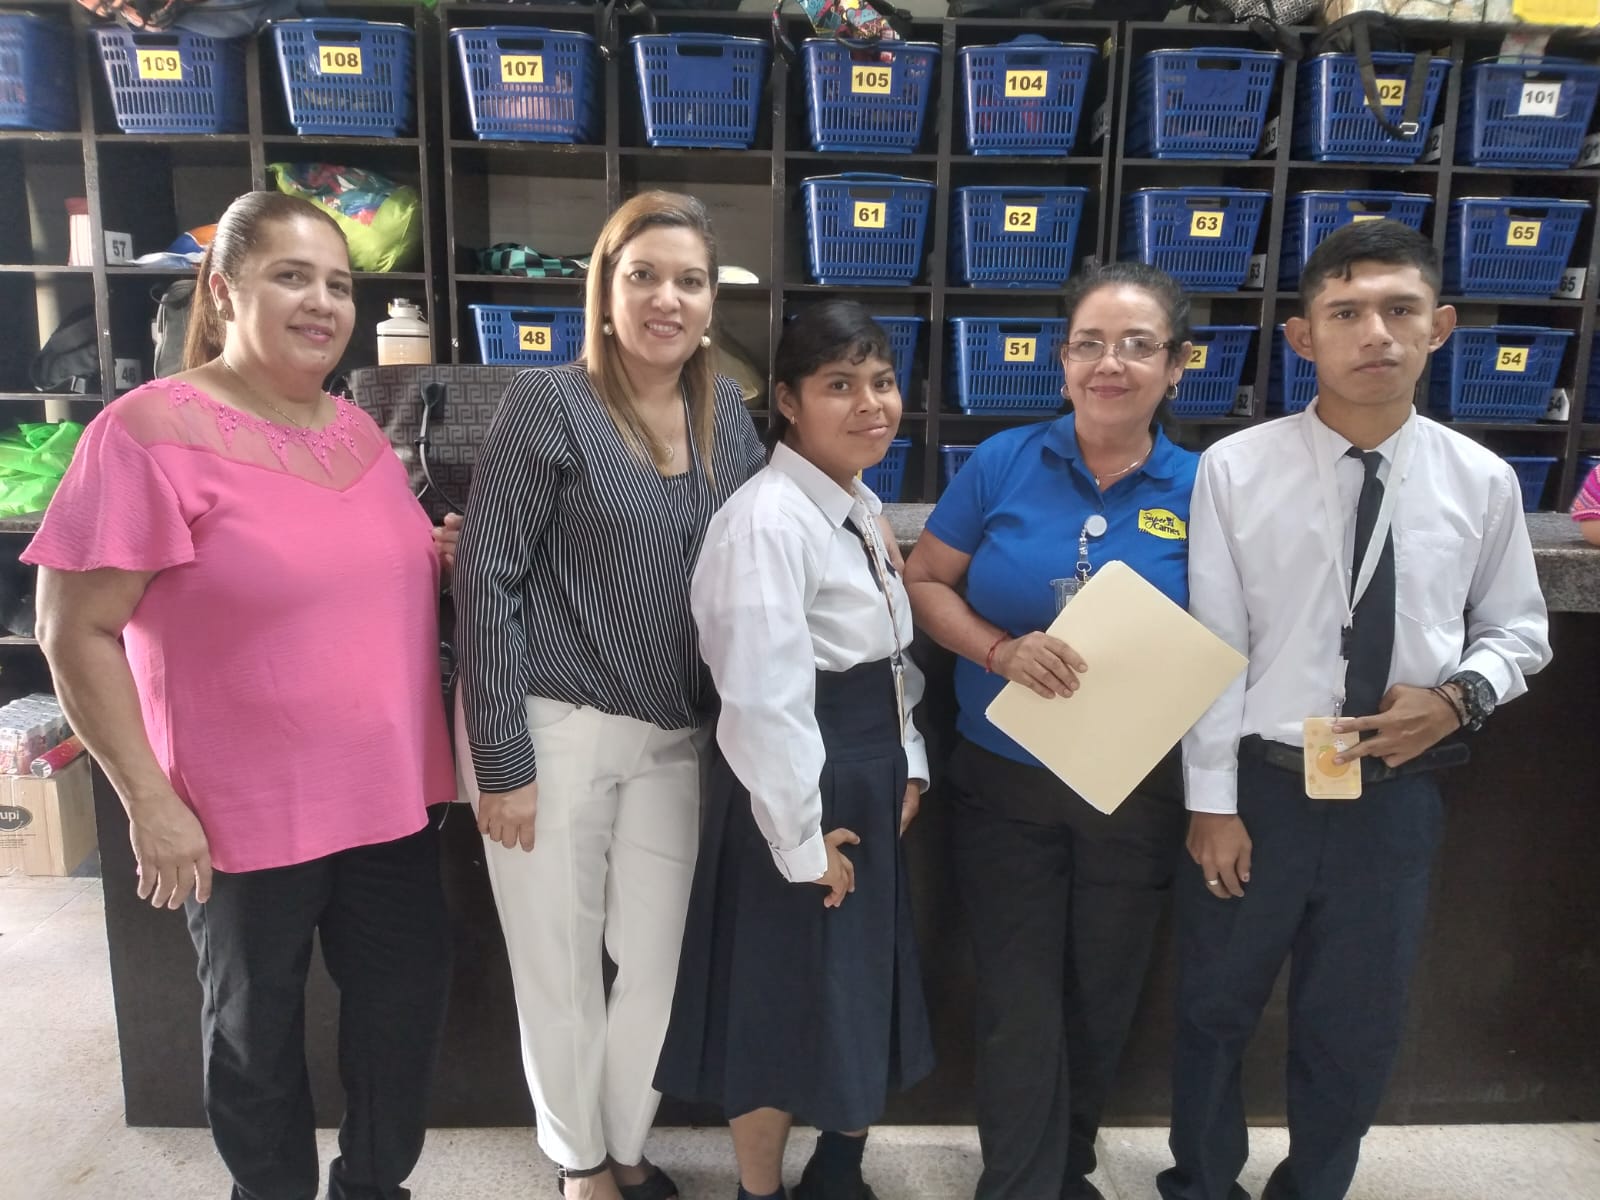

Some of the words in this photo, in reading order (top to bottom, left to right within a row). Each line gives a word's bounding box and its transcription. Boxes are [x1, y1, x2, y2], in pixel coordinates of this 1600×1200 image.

[143, 56, 177, 71] 109
[323, 52, 358, 68] 108
[504, 61, 538, 76] 107
[855, 72, 889, 88] 105
[1008, 76, 1043, 91] 104
[1380, 85, 1402, 100] 02
[1525, 90, 1556, 104] 101
[1265, 127, 1276, 147] 03
[858, 207, 881, 222] 61
[1009, 212, 1031, 226] 62
[1195, 216, 1218, 231] 63
[1512, 226, 1536, 240] 65
[112, 239, 126, 257] 57
[1560, 276, 1576, 292] 65
[523, 331, 546, 345] 48
[1009, 342, 1030, 356] 51
[1190, 350, 1201, 363] 2
[1501, 352, 1522, 366] 54
[1143, 512, 1167, 530] Super
[1154, 522, 1181, 536] Carnes
